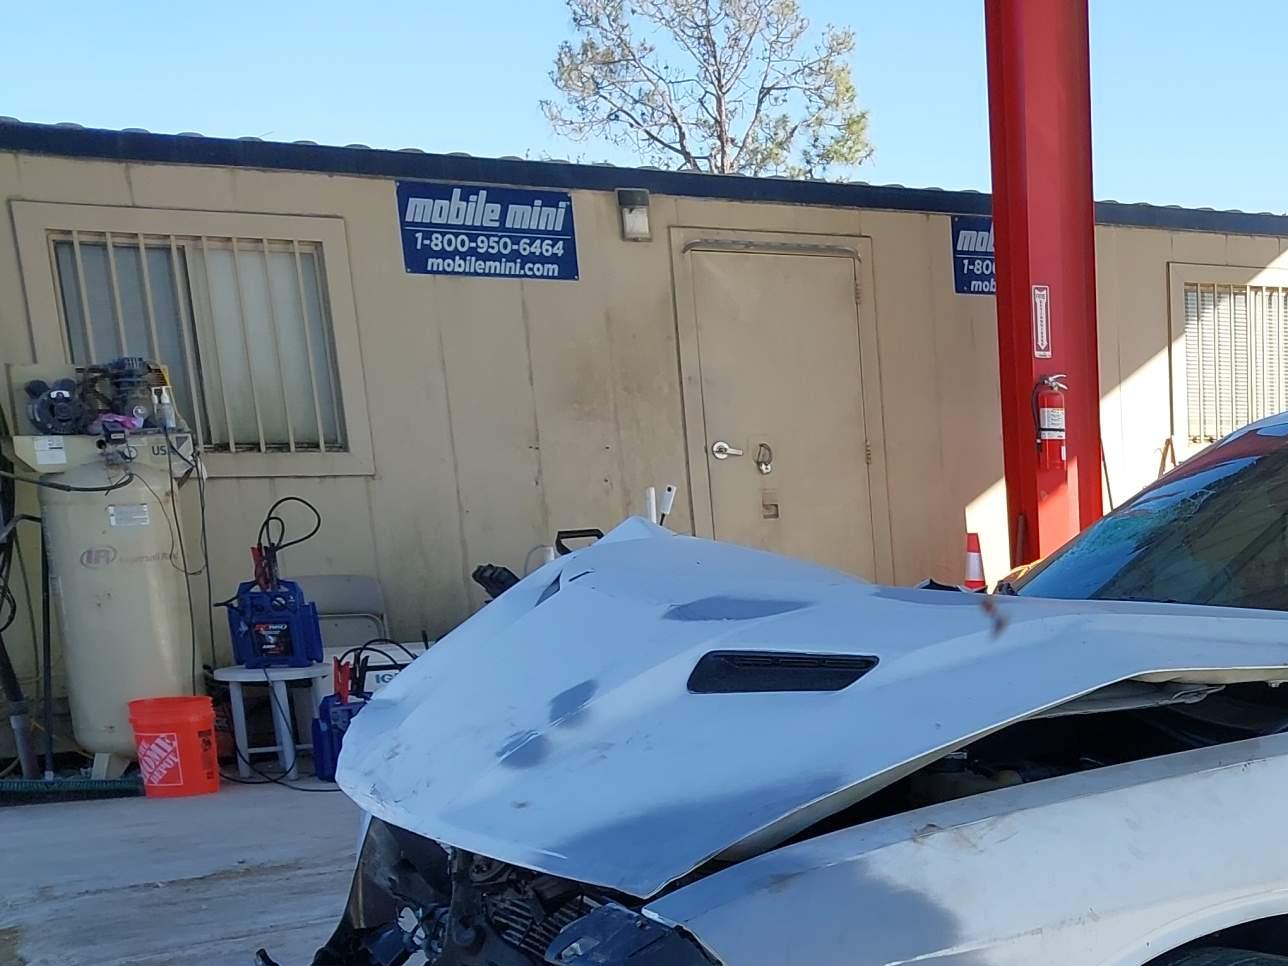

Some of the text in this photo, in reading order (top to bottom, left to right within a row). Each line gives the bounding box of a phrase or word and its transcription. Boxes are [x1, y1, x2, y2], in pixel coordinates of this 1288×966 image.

[405, 188, 567, 231] mobile mini
[415, 232, 564, 257] 1-800-950-6464
[427, 256, 559, 276] mobilemini.com
[963, 259, 996, 275] 1-80
